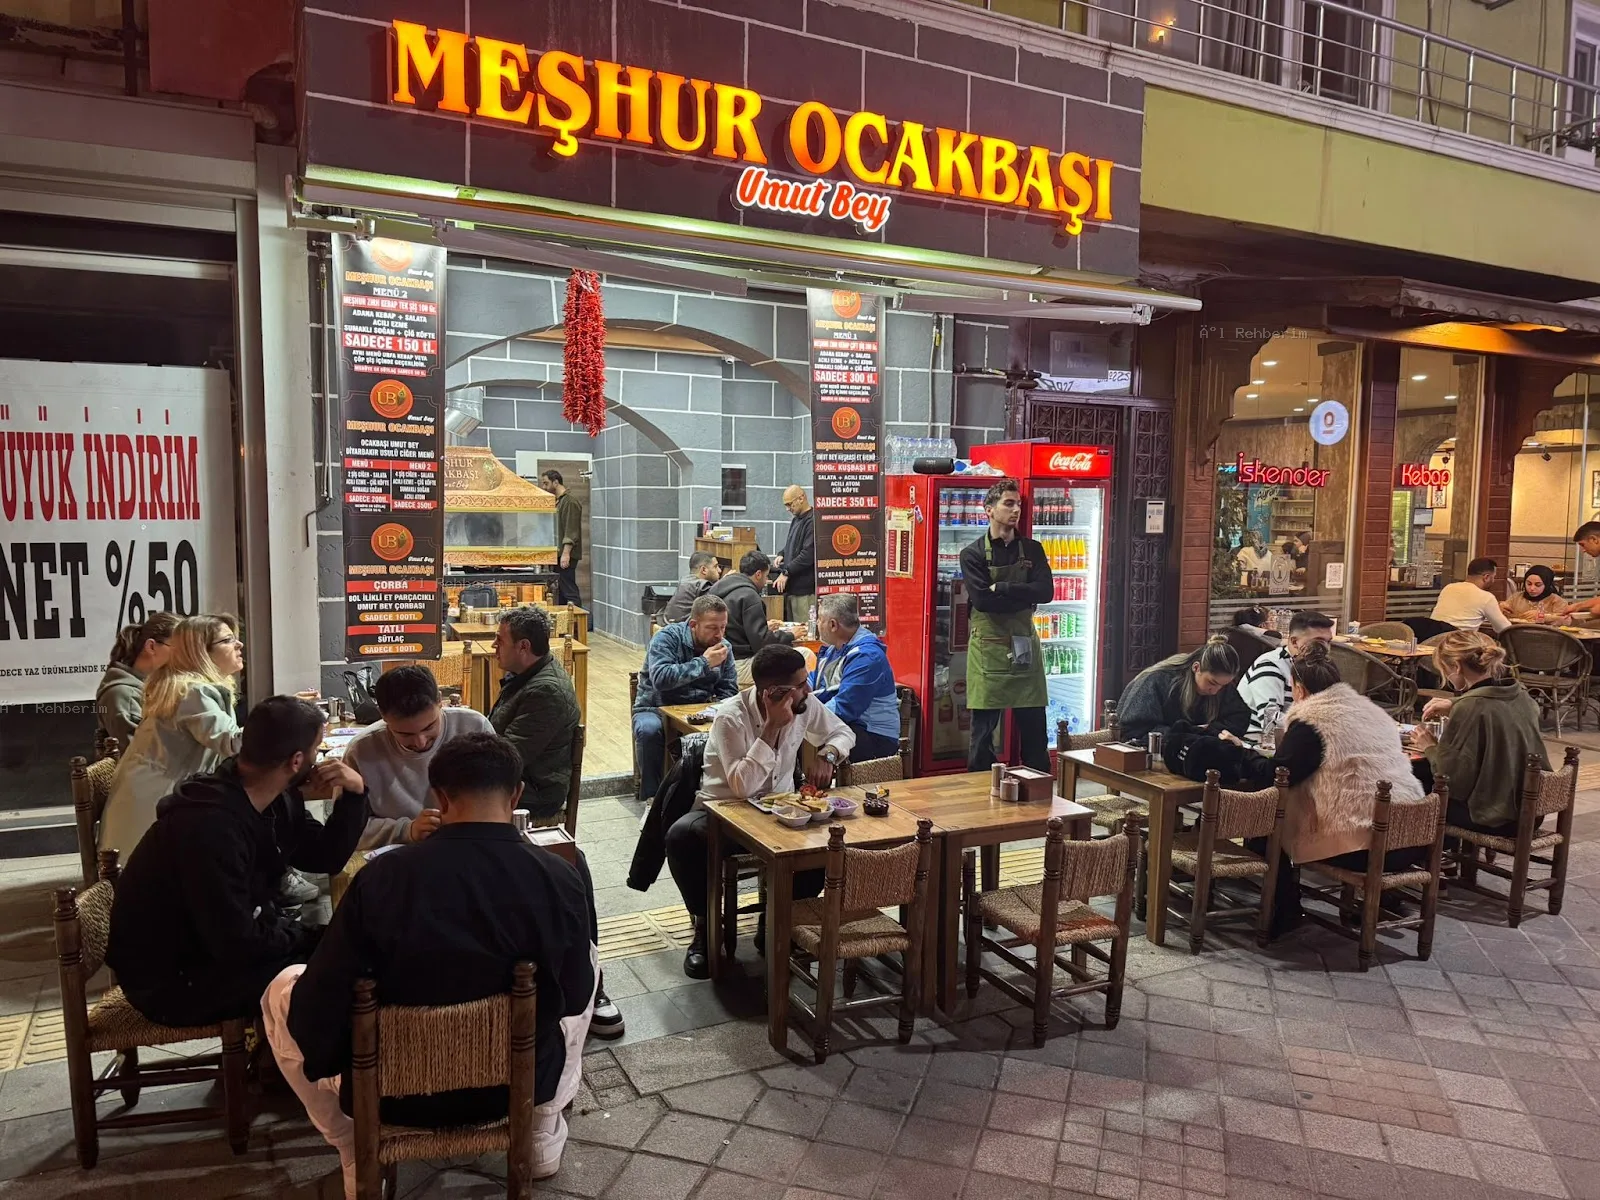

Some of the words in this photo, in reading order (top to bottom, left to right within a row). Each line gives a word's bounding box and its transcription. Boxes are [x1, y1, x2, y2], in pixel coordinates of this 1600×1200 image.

[392, 19, 768, 164] MEŞHUR
[789, 101, 1114, 237] OCAKBAŞI
[736, 166, 833, 217] Umut
[828, 182, 891, 232] Bey
[373, 287, 399, 297] MENÜ
[401, 290, 408, 298] 2
[353, 310, 374, 318] ADANA
[376, 311, 396, 319] KEBAP
[405, 315, 427, 323] SALATA
[344, 325, 372, 333] SUMAKLI
[374, 327, 395, 335] SOĞAN
[404, 330, 415, 338] ÇİĞ
[416, 331, 435, 339] KÖFTE
[345, 333, 393, 349] SADECE
[397, 339, 419, 352] 150
[815, 371, 847, 382] SADECE
[850, 373, 865, 383] 300
[377, 392, 396, 405] UB
[836, 417, 850, 428] UB
[361, 439, 389, 449] OCAKBAŞI
[408, 441, 419, 449] BEY
[346, 446, 378, 456] DİYARBAKIR
[380, 449, 398, 457] USULÜ
[400, 450, 417, 458] CİĞER
[418, 450, 434, 459] MENÜ
[83, 407, 200, 520] İNDİRİM
[352, 459, 369, 467] MENÜ
[409, 461, 426, 470] MENÜ
[838, 464, 866, 472] KUŞBAŞI
[1238, 452, 1330, 487] İskender
[1401, 464, 1451, 491] Kebap
[816, 497, 847, 507] SADECE
[850, 497, 864, 507] 350
[377, 535, 397, 548] UB
[836, 534, 850, 545] UB
[0, 542, 88, 640] NET
[104, 540, 199, 640] %50
[374, 581, 408, 592] ÇORBA
[363, 593, 382, 601] İLİKLİ
[394, 594, 434, 602] PARÇACIKLI
[357, 603, 378, 611] UMUT
[394, 603, 425, 611] ÇORBASI
[365, 614, 393, 622] SADECE
[378, 625, 405, 634] TATLI
[378, 634, 405, 643] SÜTLAÇ
[365, 645, 393, 653] SADECE
[42, 664, 98, 675] ÜRÜNLERİNDE
